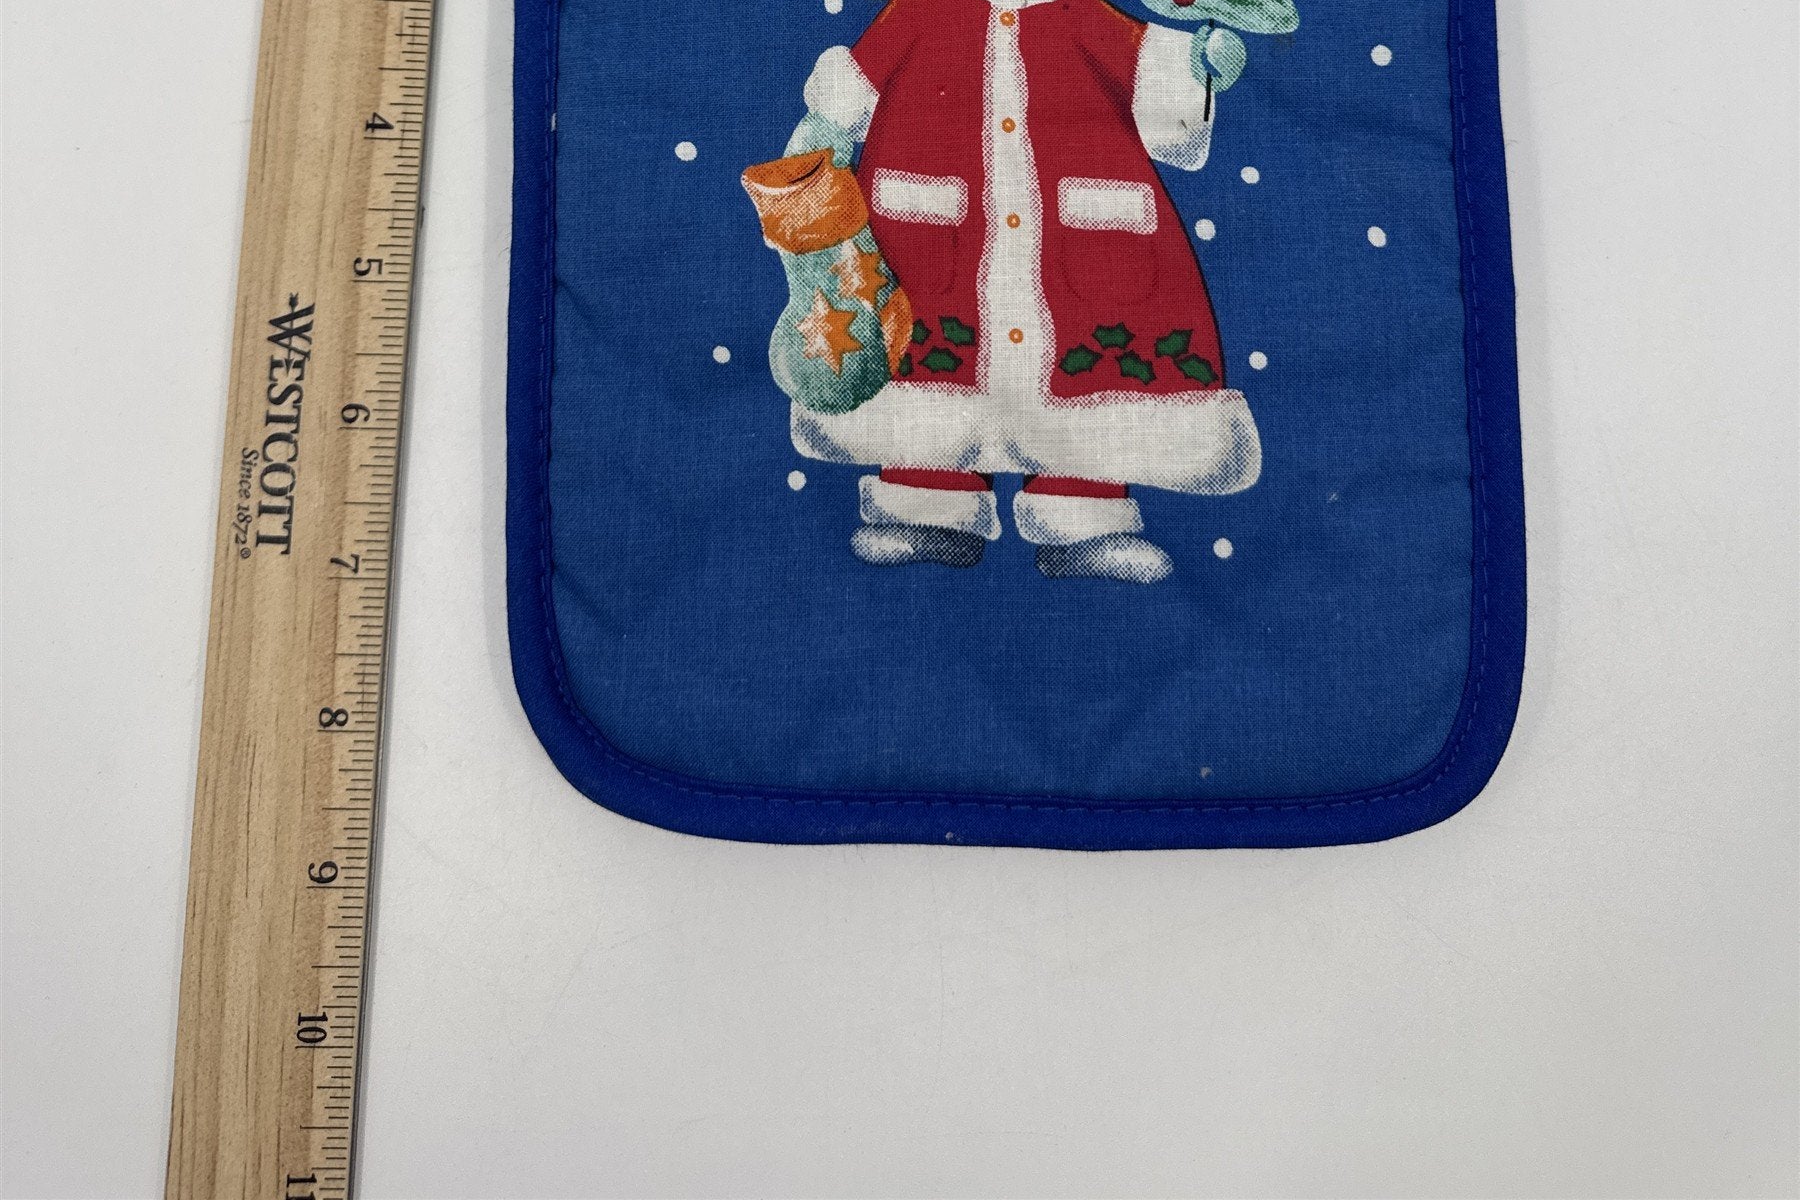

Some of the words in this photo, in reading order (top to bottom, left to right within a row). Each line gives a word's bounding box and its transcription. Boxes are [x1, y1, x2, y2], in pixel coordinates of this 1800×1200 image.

[365, 112, 395, 134] 4
[353, 257, 383, 277] 5
[341, 404, 371, 424] 6
[256, 302, 316, 555] WESTCOTT
[239, 447, 259, 499] Since
[330, 553, 360, 574] 7
[319, 707, 349, 728] 8
[308, 861, 339, 884] 9
[297, 1012, 329, 1045] 10
